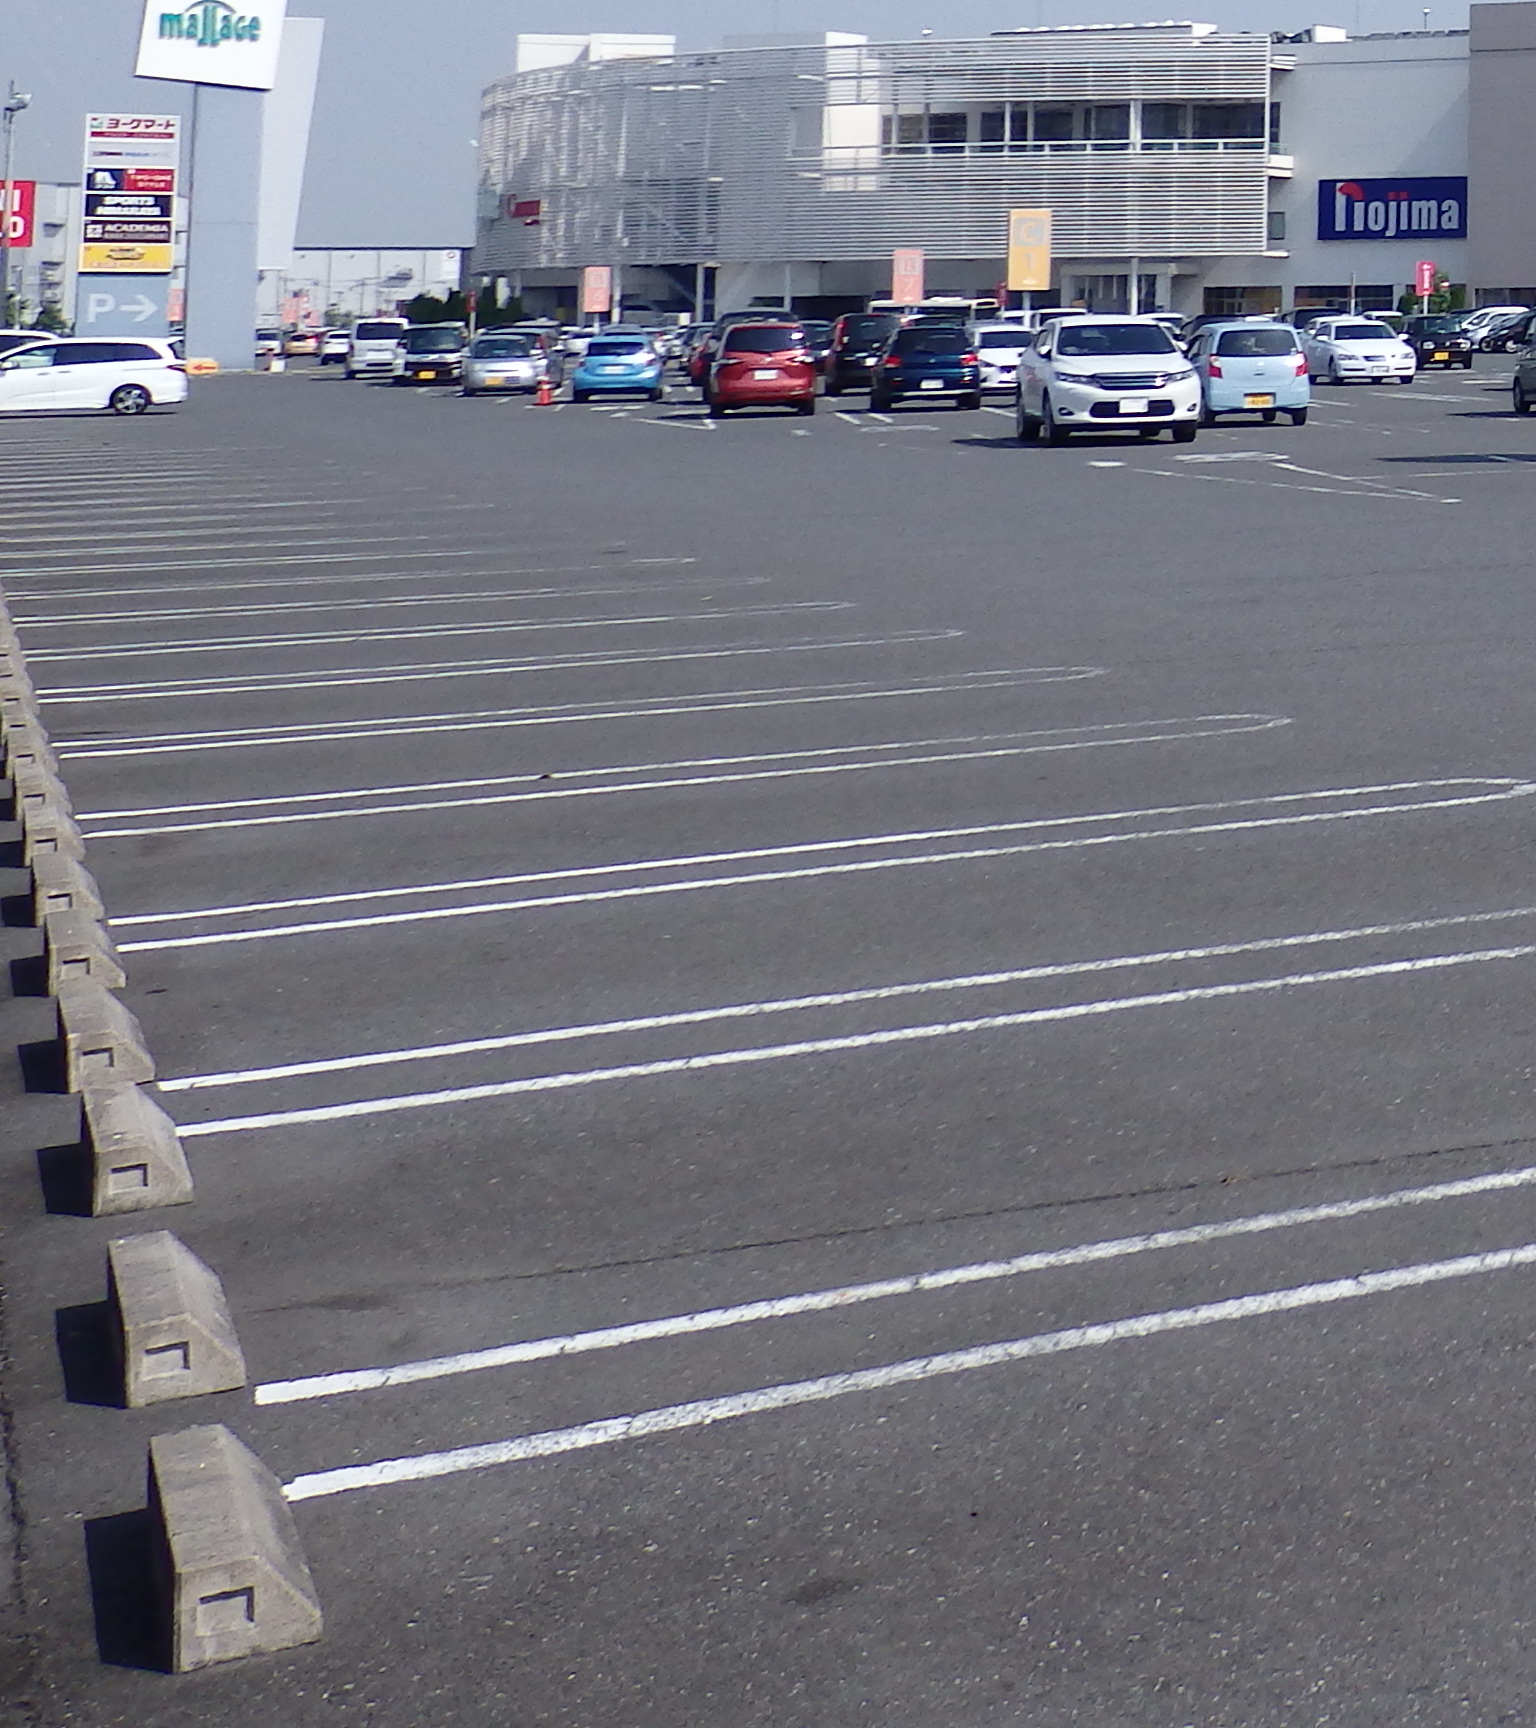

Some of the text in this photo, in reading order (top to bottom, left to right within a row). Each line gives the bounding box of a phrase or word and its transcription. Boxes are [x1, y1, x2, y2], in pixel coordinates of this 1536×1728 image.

[106, 118, 176, 129] ヨークマート
[1334, 181, 1460, 237] nojima
[86, 293, 116, 323] P
